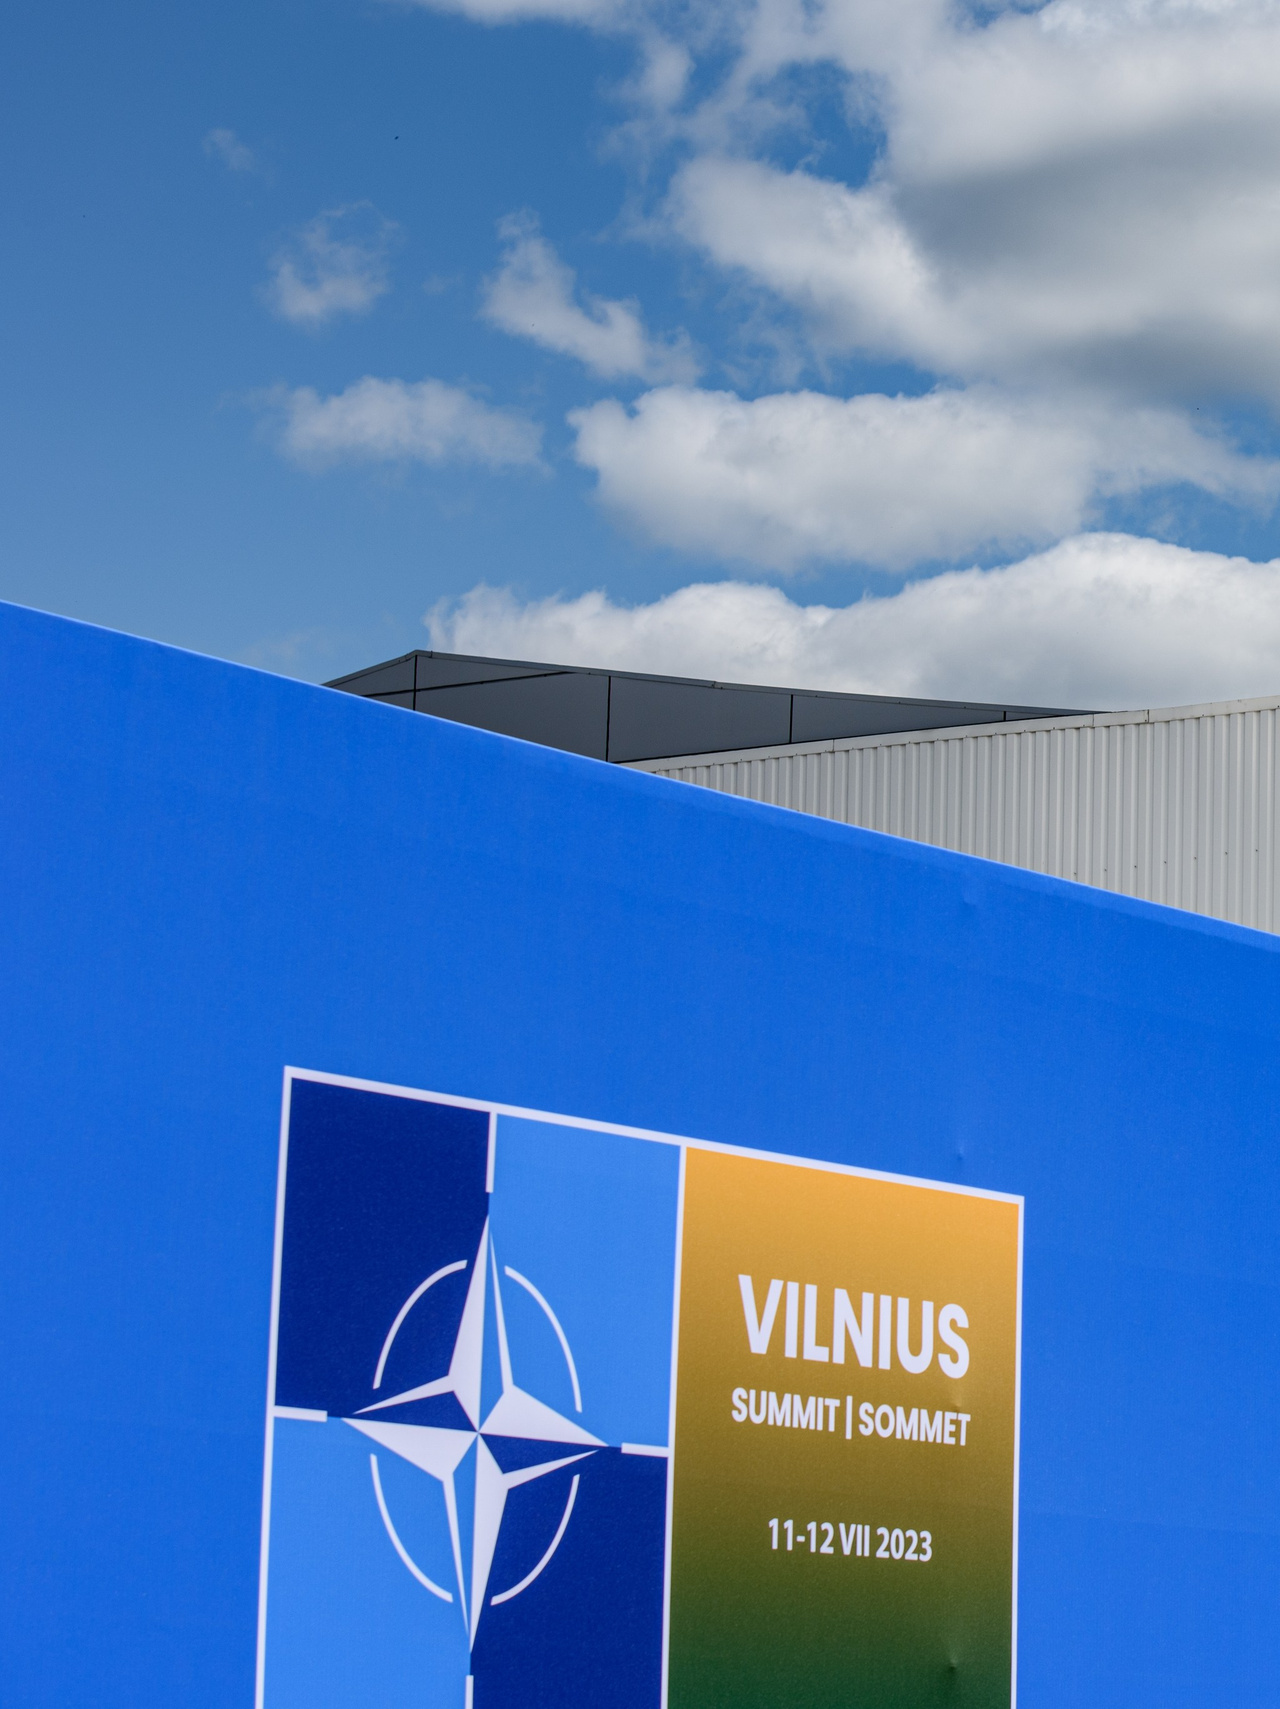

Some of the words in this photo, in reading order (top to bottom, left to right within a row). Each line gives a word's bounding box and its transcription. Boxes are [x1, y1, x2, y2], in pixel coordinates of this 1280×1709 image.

[738, 1274, 970, 1379] VILNIUS
[732, 1387, 840, 1432] SUMMIT
[858, 1402, 971, 1446] SOMMET
[768, 1518, 834, 1554] 11-12
[839, 1523, 870, 1557] VII
[875, 1527, 933, 1562] 2023
